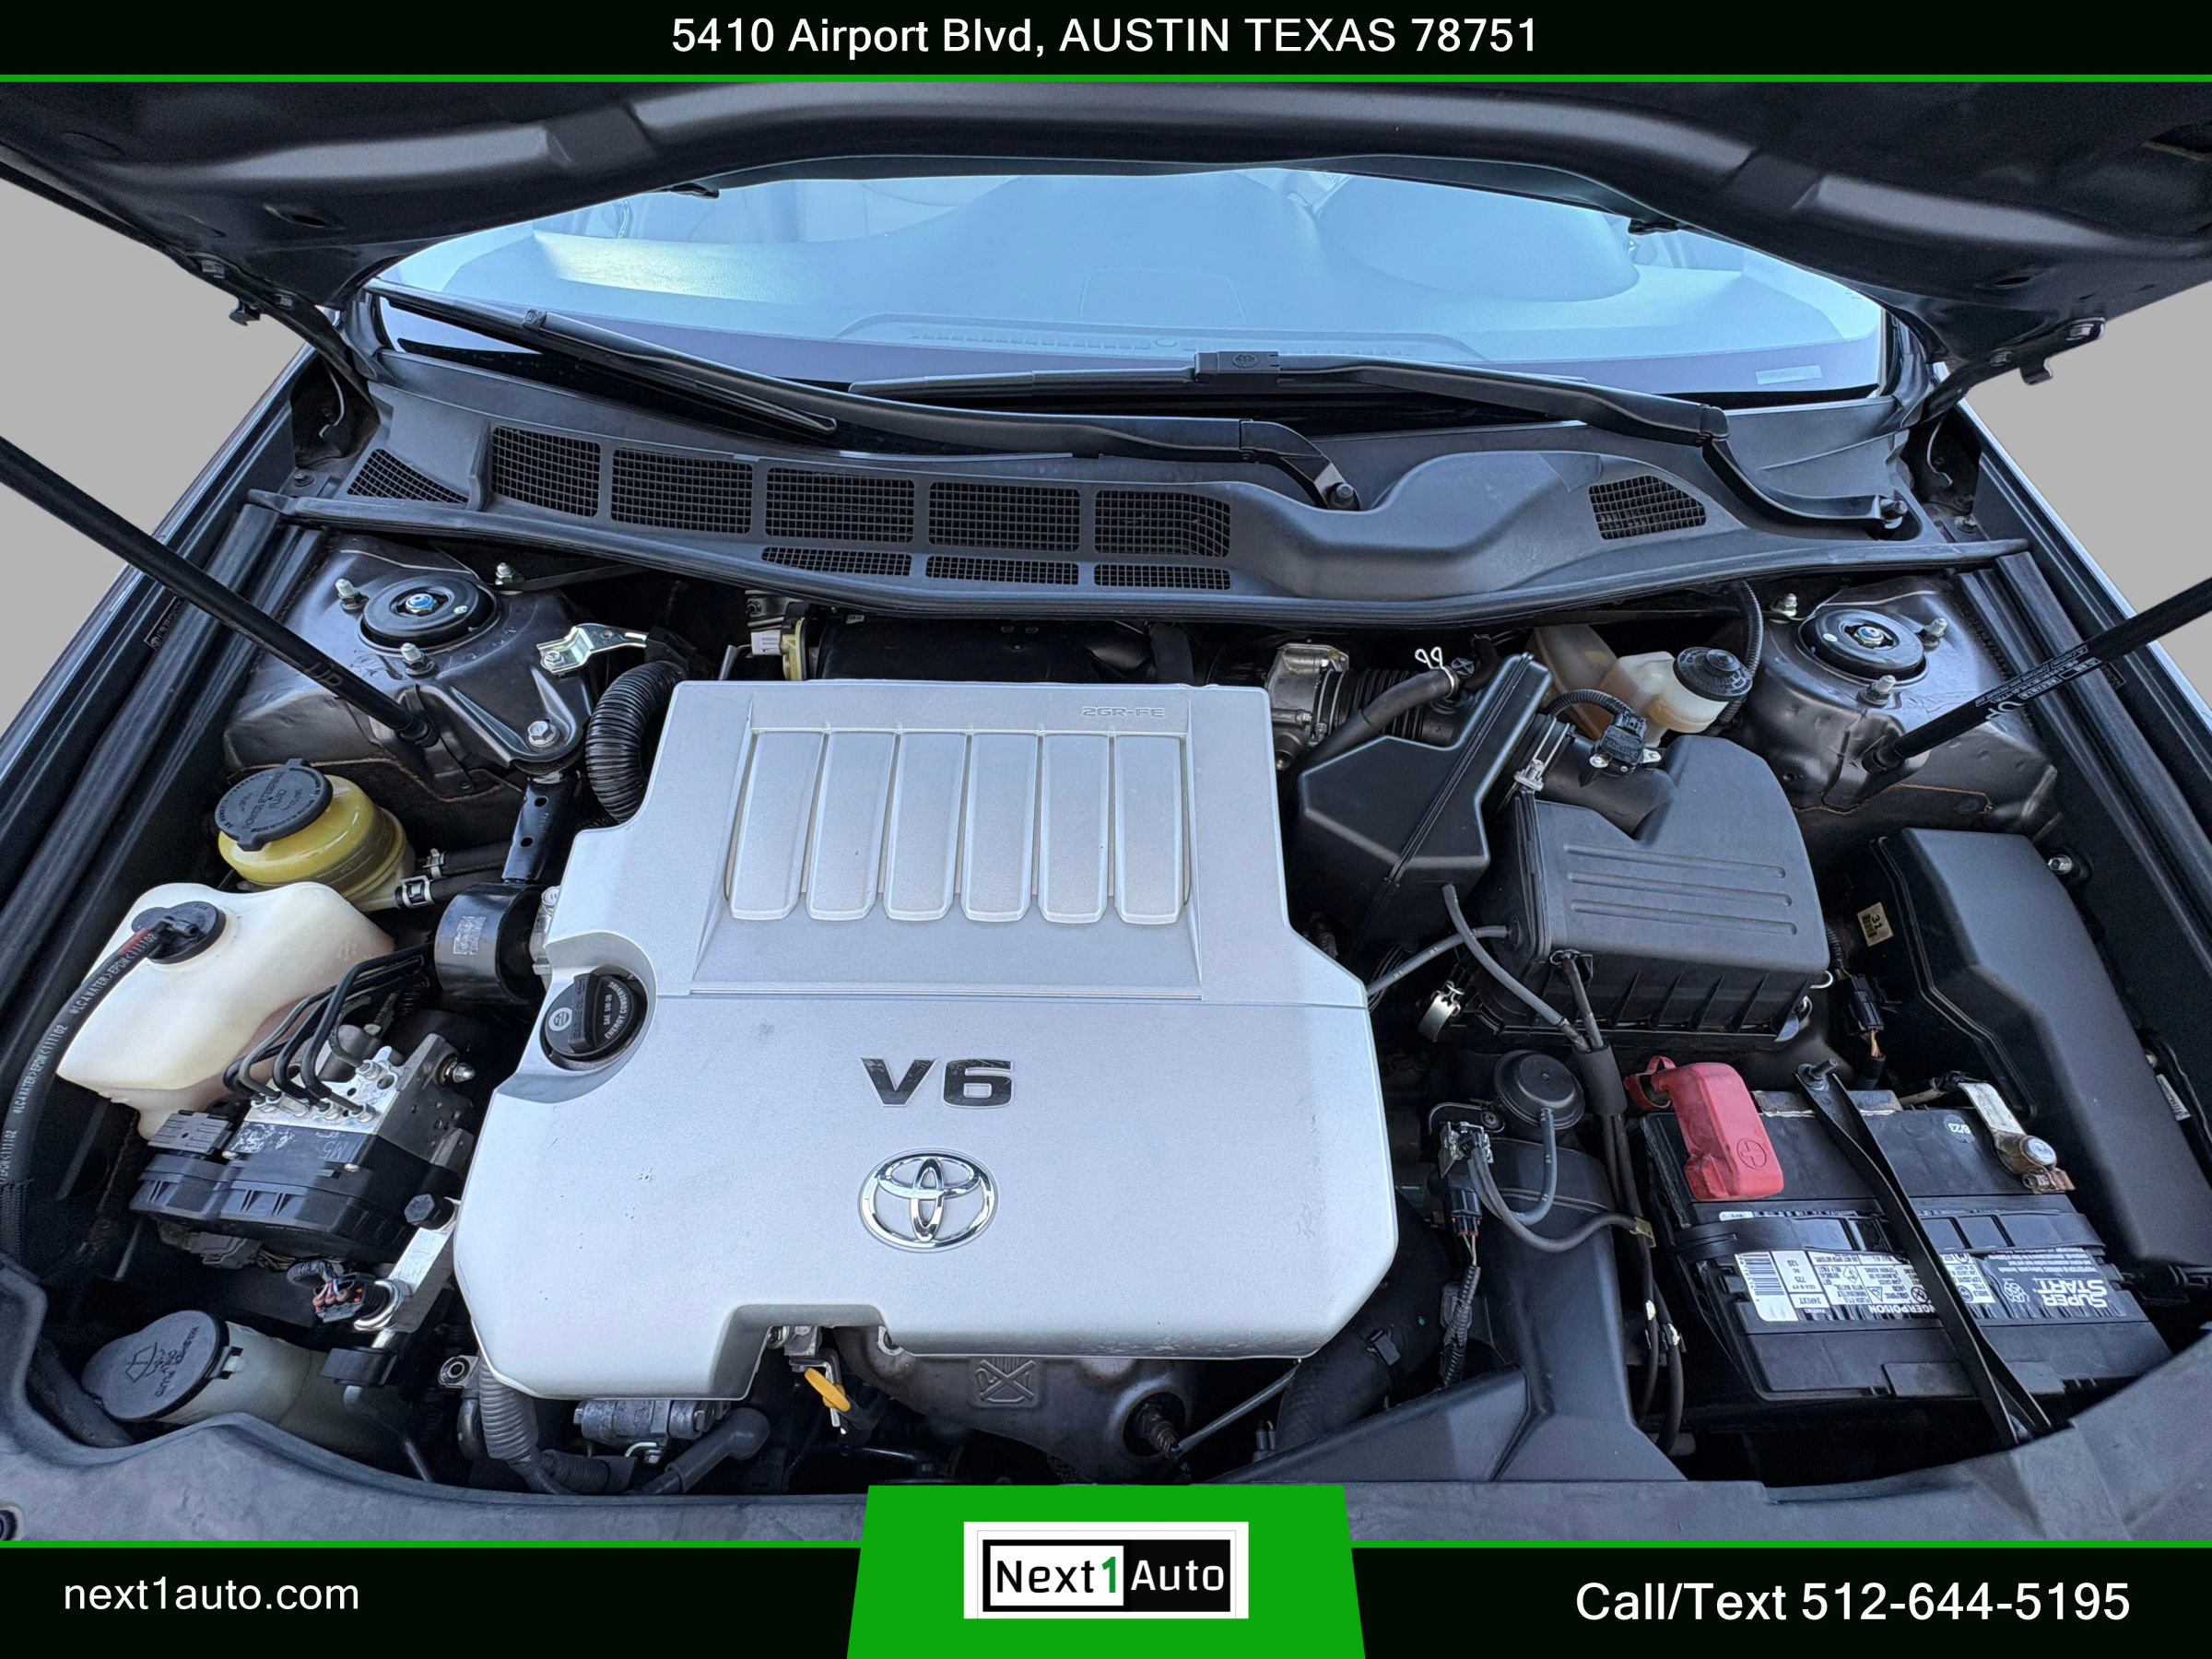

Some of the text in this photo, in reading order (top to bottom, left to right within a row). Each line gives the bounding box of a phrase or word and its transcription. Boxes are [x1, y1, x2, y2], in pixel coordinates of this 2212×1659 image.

[1081, 706, 1166, 718] 2GR-FE
[604, 981, 628, 1040] ENERGY CONSERVING
[859, 1057, 1013, 1108] V6
[2037, 1278, 2107, 1295] START
[2041, 1293, 2108, 1308] SUPER
